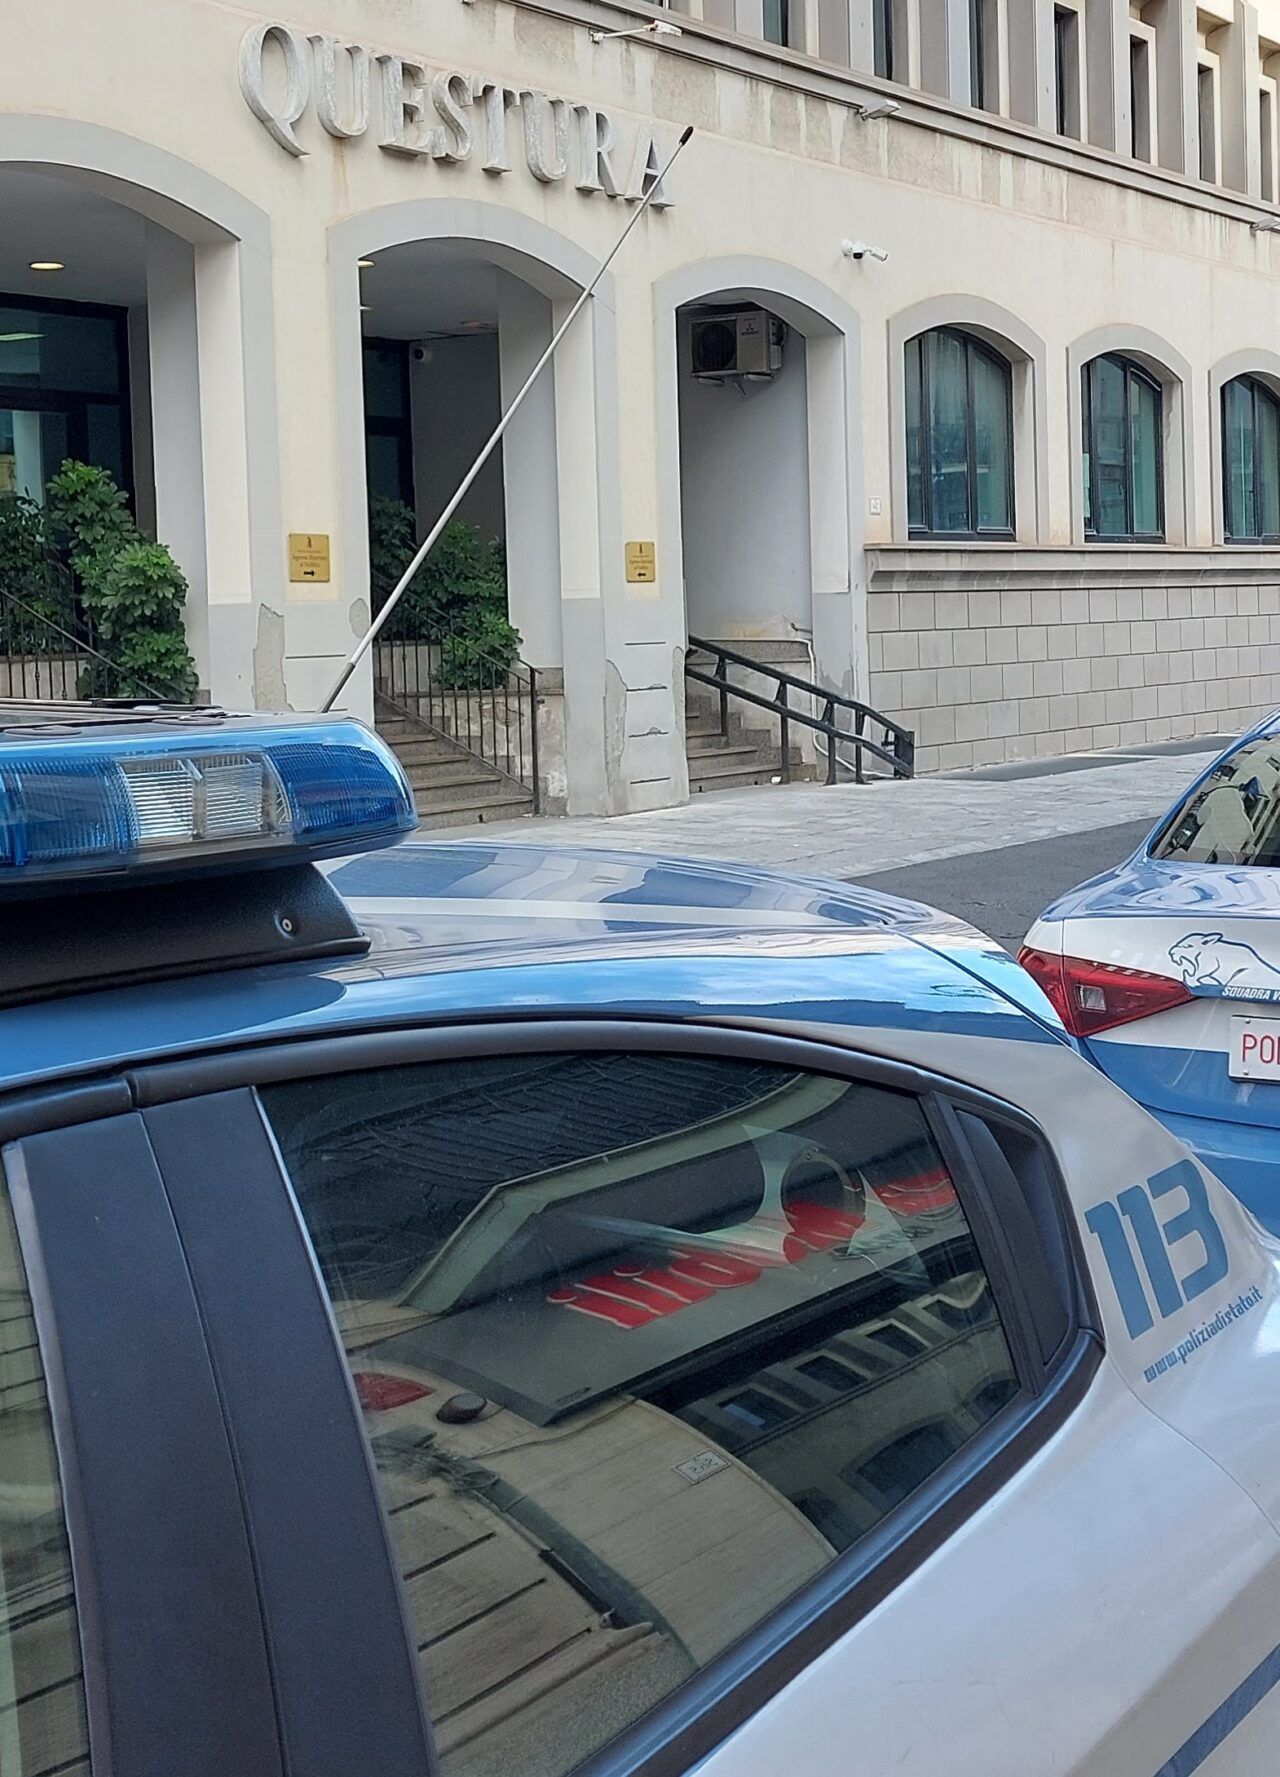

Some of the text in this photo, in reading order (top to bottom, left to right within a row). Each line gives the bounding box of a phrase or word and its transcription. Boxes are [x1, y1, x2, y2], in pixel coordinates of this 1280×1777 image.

[239, 20, 677, 209] QUESTURA
[1221, 986, 1271, 1001] SQUADRA
[1084, 1159, 1229, 1340] 113
[1143, 1285, 1264, 1384] www.poliziadistato.it
